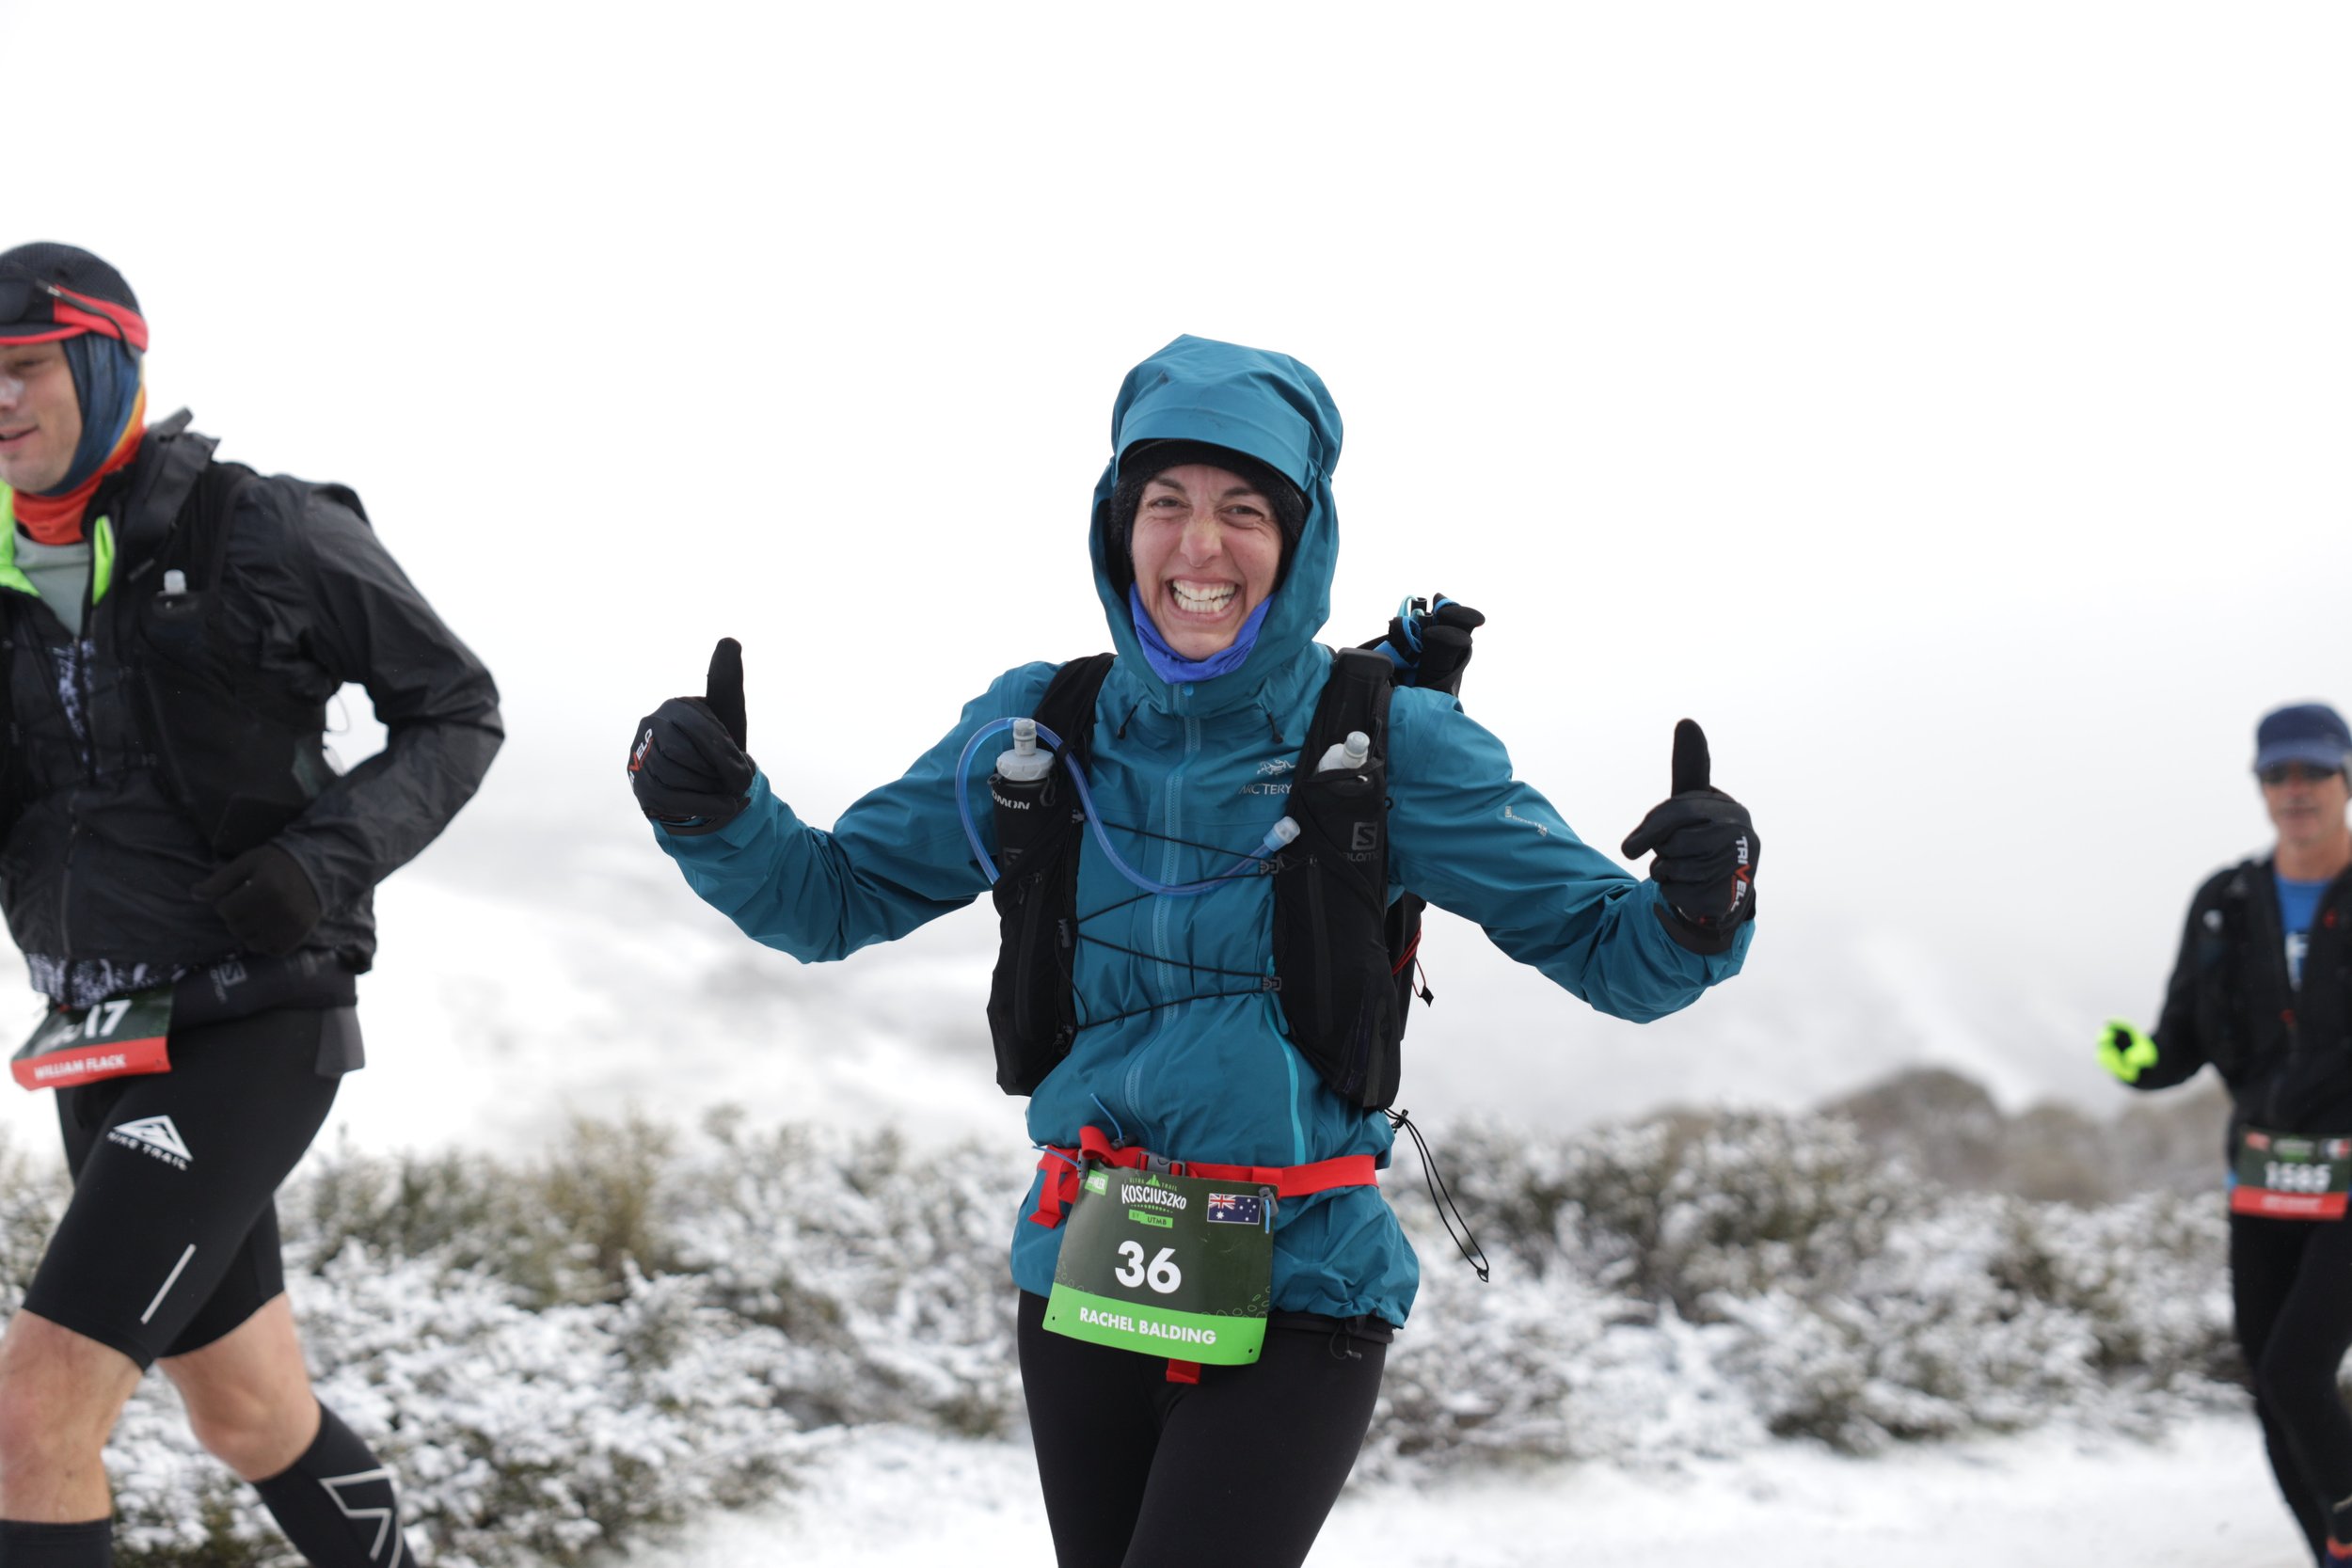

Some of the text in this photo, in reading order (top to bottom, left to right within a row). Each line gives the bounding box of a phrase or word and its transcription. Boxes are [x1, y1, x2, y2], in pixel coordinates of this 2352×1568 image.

[35, 1053, 126, 1080] WILLIAM FLACK
[1121, 1183, 1186, 1210] KOSCIUSZKO
[1147, 1216, 1167, 1226] UTMB
[1115, 1240, 1182, 1294] 36
[1079, 1307, 1216, 1345] RACHEL BALDING
